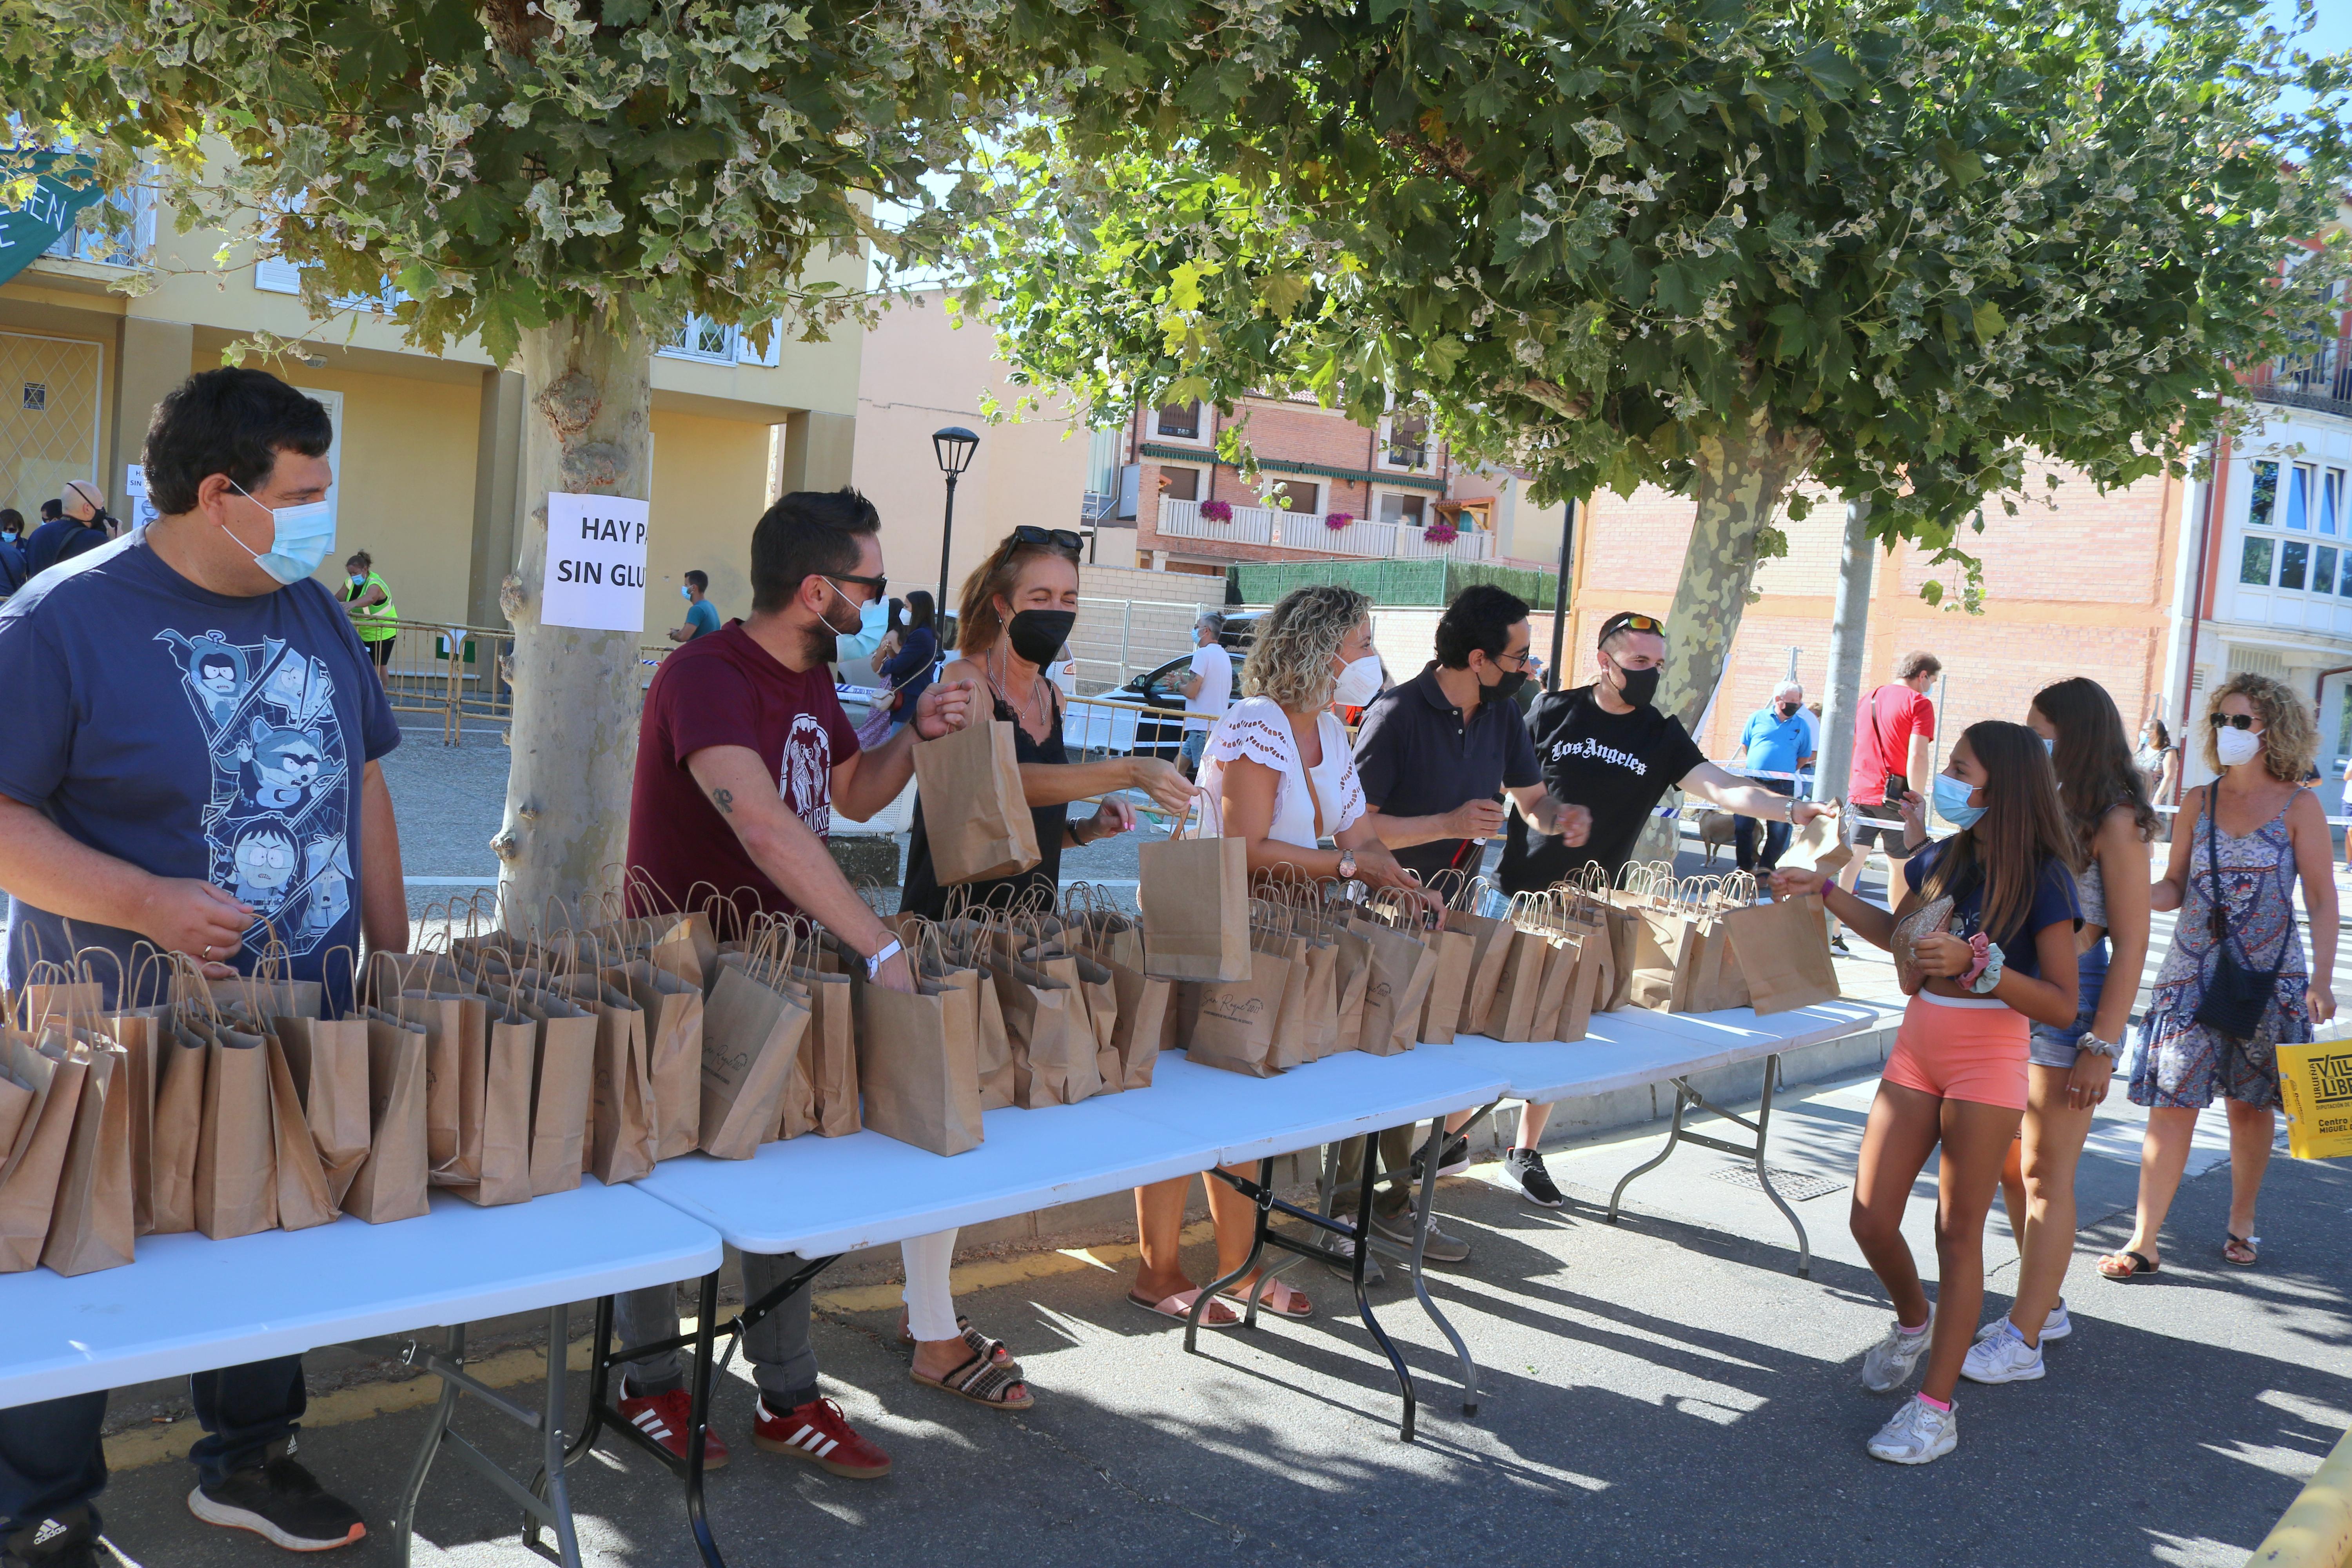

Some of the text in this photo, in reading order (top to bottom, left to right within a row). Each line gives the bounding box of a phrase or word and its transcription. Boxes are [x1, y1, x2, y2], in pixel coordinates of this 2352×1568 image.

[582, 517, 630, 543] HAY
[558, 560, 646, 588] SIN GLU
[1552, 737, 1647, 776] Los Angeles
[1202, 990, 1260, 1016] San Roque 2021
[2309, 1063, 2321, 1098] URUEÑA
[2316, 1102, 2343, 1110] DIPUTACIÓN
[2319, 1118, 2348, 1127] Centro
[2319, 1125, 2348, 1134] MIGUEL
[34, 1525, 67, 1545] adidas
